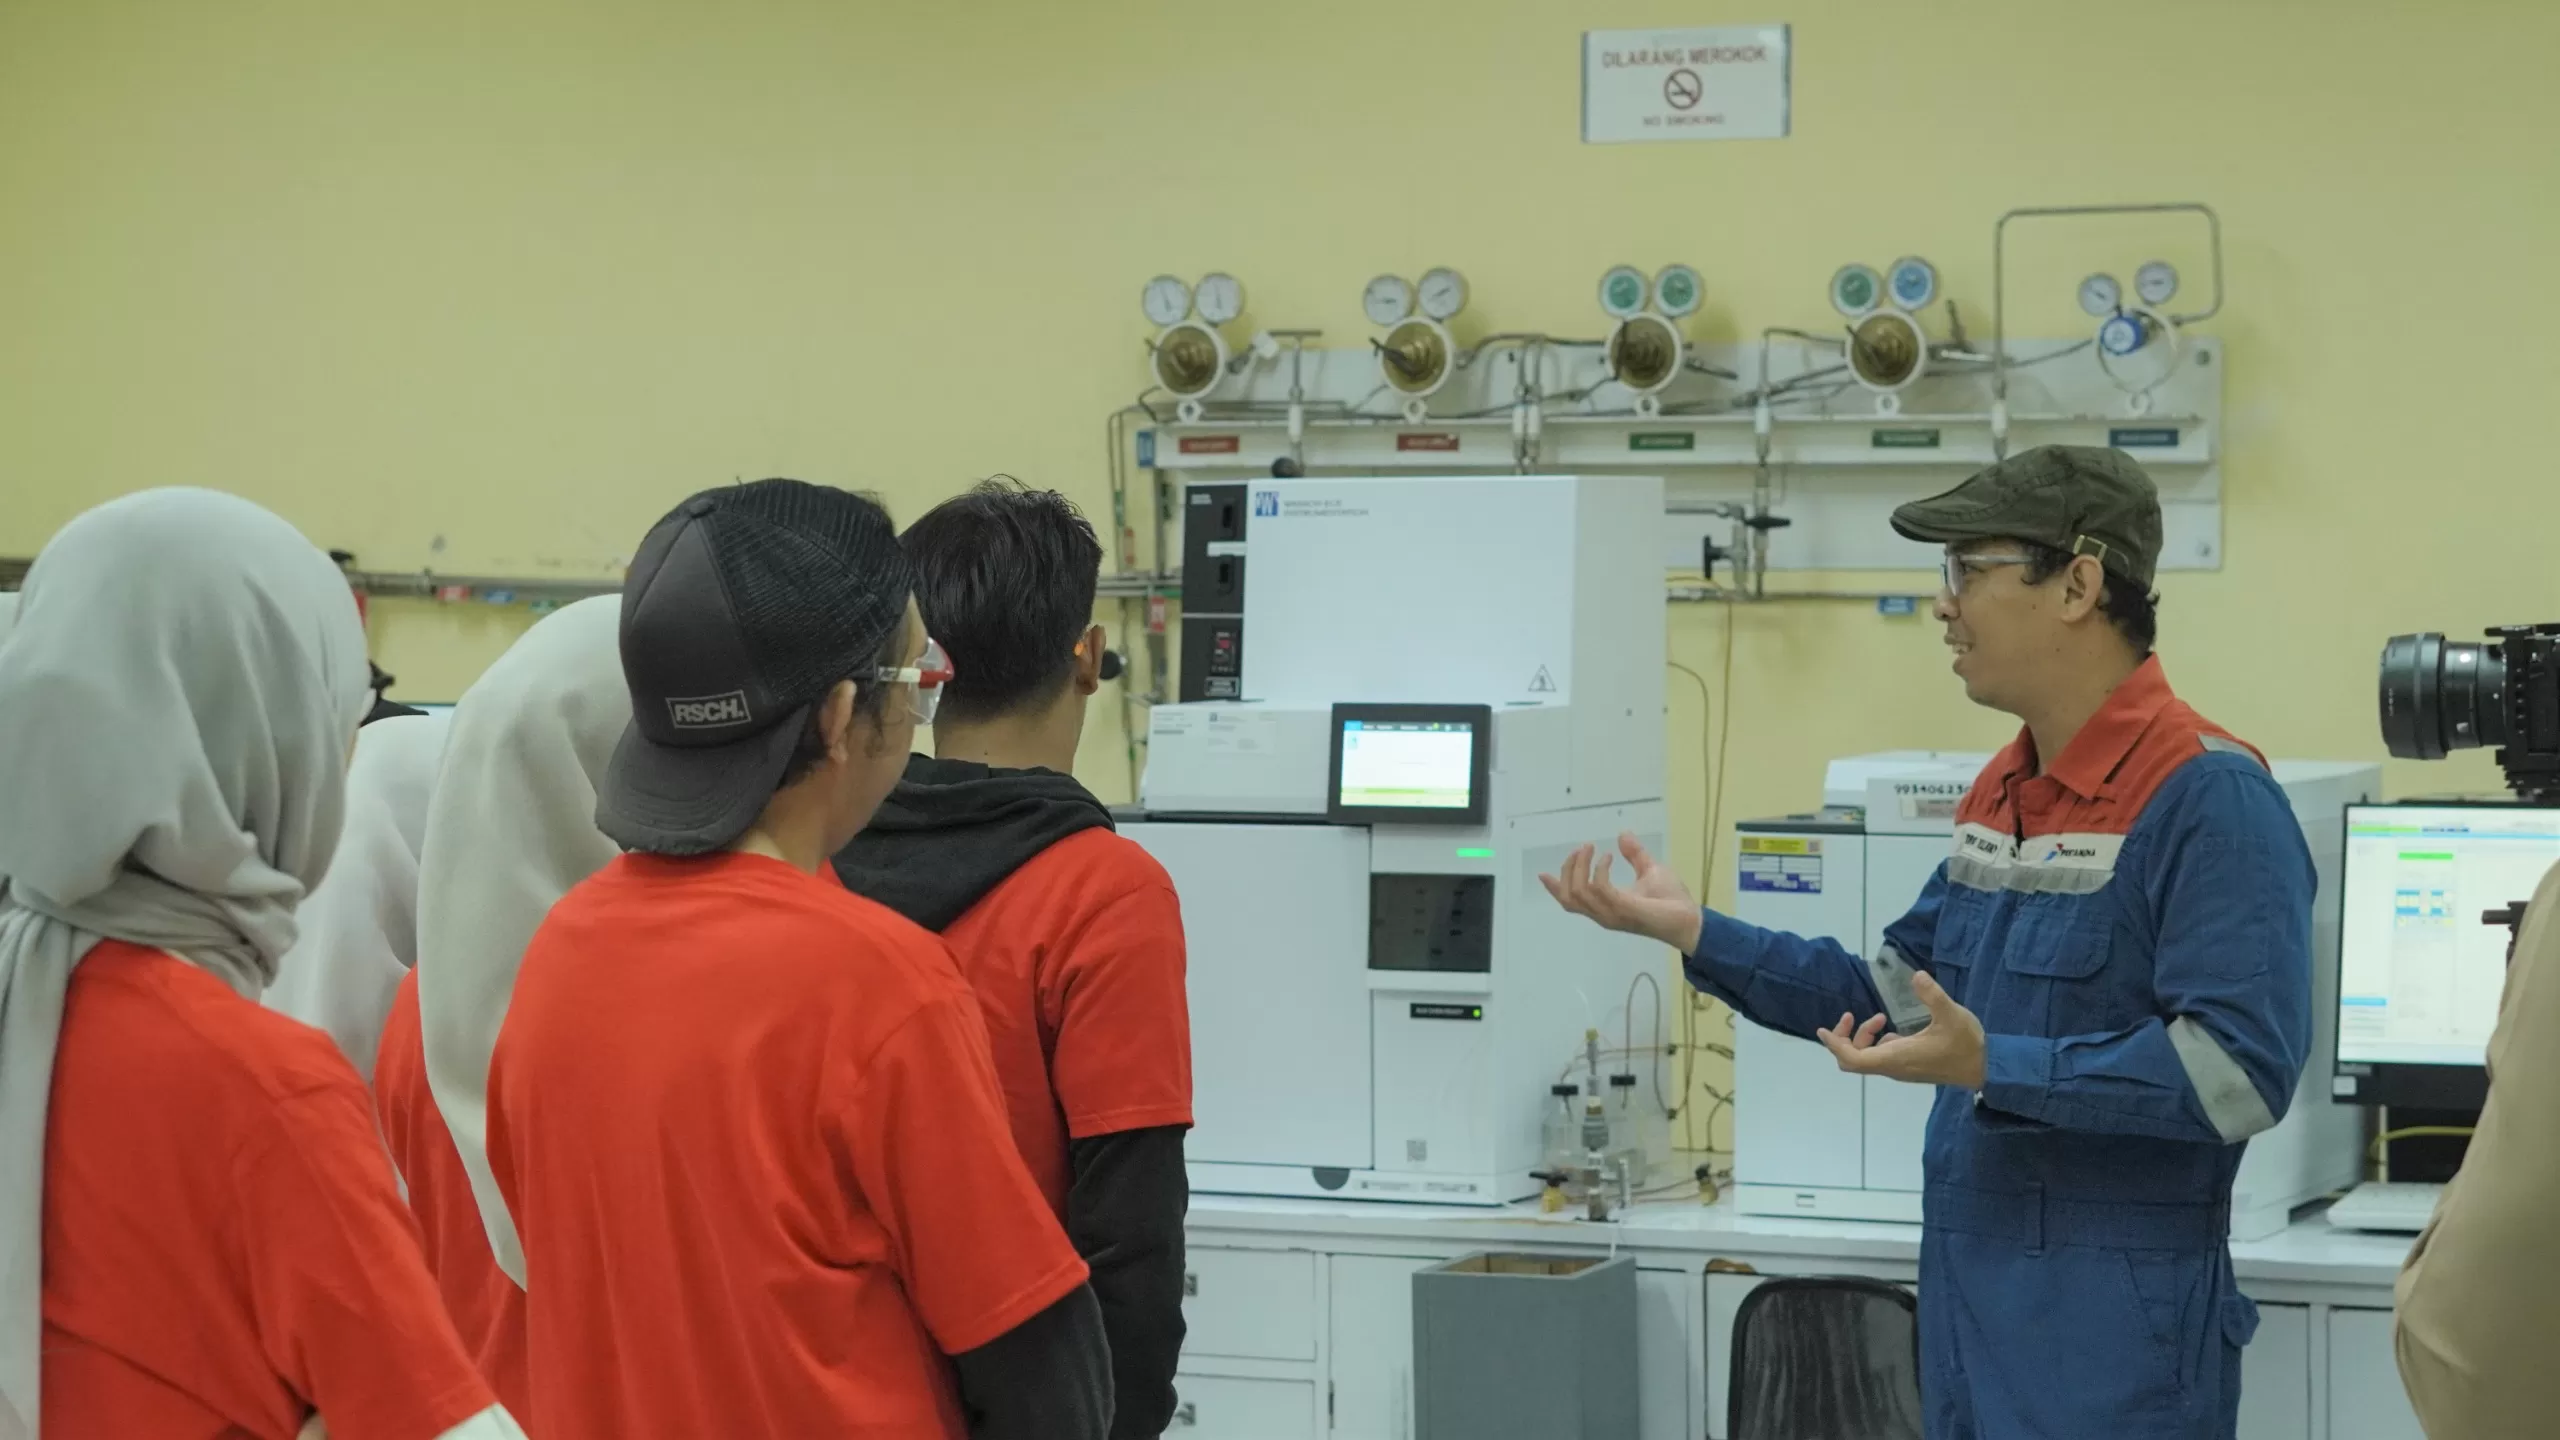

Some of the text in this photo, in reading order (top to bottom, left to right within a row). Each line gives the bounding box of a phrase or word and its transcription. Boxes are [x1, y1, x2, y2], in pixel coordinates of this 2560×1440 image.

[1602, 45, 1767, 67] DILARANG MEROKOK
[1643, 113, 1724, 126] NO SMOKING
[674, 697, 744, 722] RSCH.
